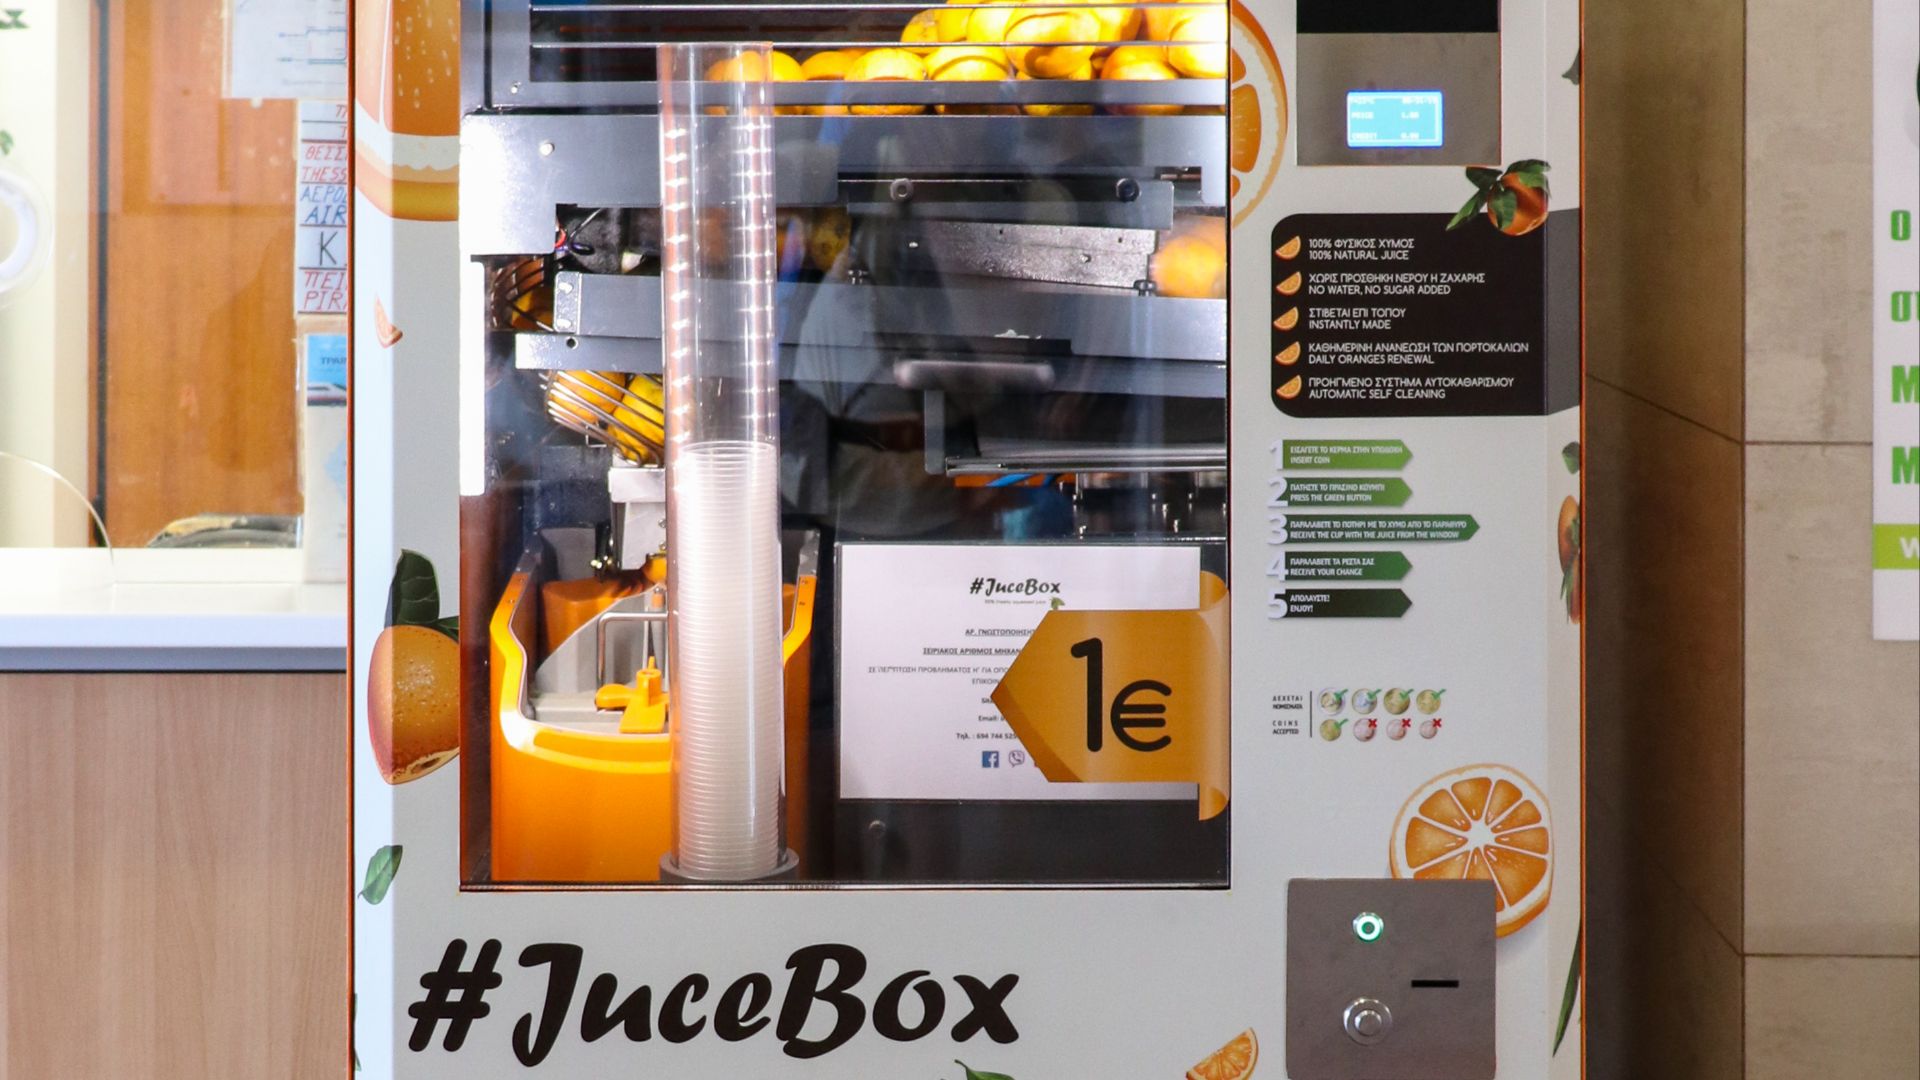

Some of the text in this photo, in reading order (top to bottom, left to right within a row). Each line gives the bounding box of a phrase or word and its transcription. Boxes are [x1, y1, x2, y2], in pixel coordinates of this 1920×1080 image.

[304, 145, 347, 161] ΘΕΣΣ
[300, 185, 347, 203] ΑΕΡΟ
[1309, 238, 1415, 249] 100% ΦΥΣΙΚΟΣ ΧΥΜΟΣ
[1309, 250, 1409, 260] 100% NATURAL JUICE
[304, 271, 347, 291] ΠΕΙ
[1309, 273, 1486, 283] ΧΩΡΙΣ ΠΡΟΣΘΗΚΗ ΝΕΡΟΥ Η ΖΑΧΑΡΗΣ
[1308, 285, 1451, 295] NO WATER, NO SUGAR ADDED
[1309, 307, 1406, 318] ΣΤΙΒΕΤΑΙ ΕΠΙ ΤΟΠΟΥ
[1309, 319, 1392, 329] INSTANTLY MADE
[1308, 342, 1529, 353] ΚΑΘΗΜΕΡΙΝΗ ΑΝΑΝΕΩΣΗ ΤΩΝ ΠΟΡΤΟΚΑΛΙΩΝ
[1308, 354, 1434, 364] DAILY ORANGES RENEWAL
[1309, 377, 1515, 388] ΠΡΟΗΓΜΕΝΟ ΣΥΣΤΗΜΑ ΑΥΤΟΚΑΘΑΡΙΣΜΟΥ
[1309, 389, 1446, 399] AUTOMATIC SELF CLEANING
[1268, 477, 1288, 507] 2
[1268, 513, 1288, 545] 3
[1266, 551, 1288, 582] 4
[1290, 568, 1363, 576] RECEIVE YOUR CHANGE
[970, 577, 1061, 596] #JuceBox
[1268, 587, 1288, 618] 5
[1070, 637, 1172, 752] 1€
[407, 938, 1020, 1067] #JuceBox
